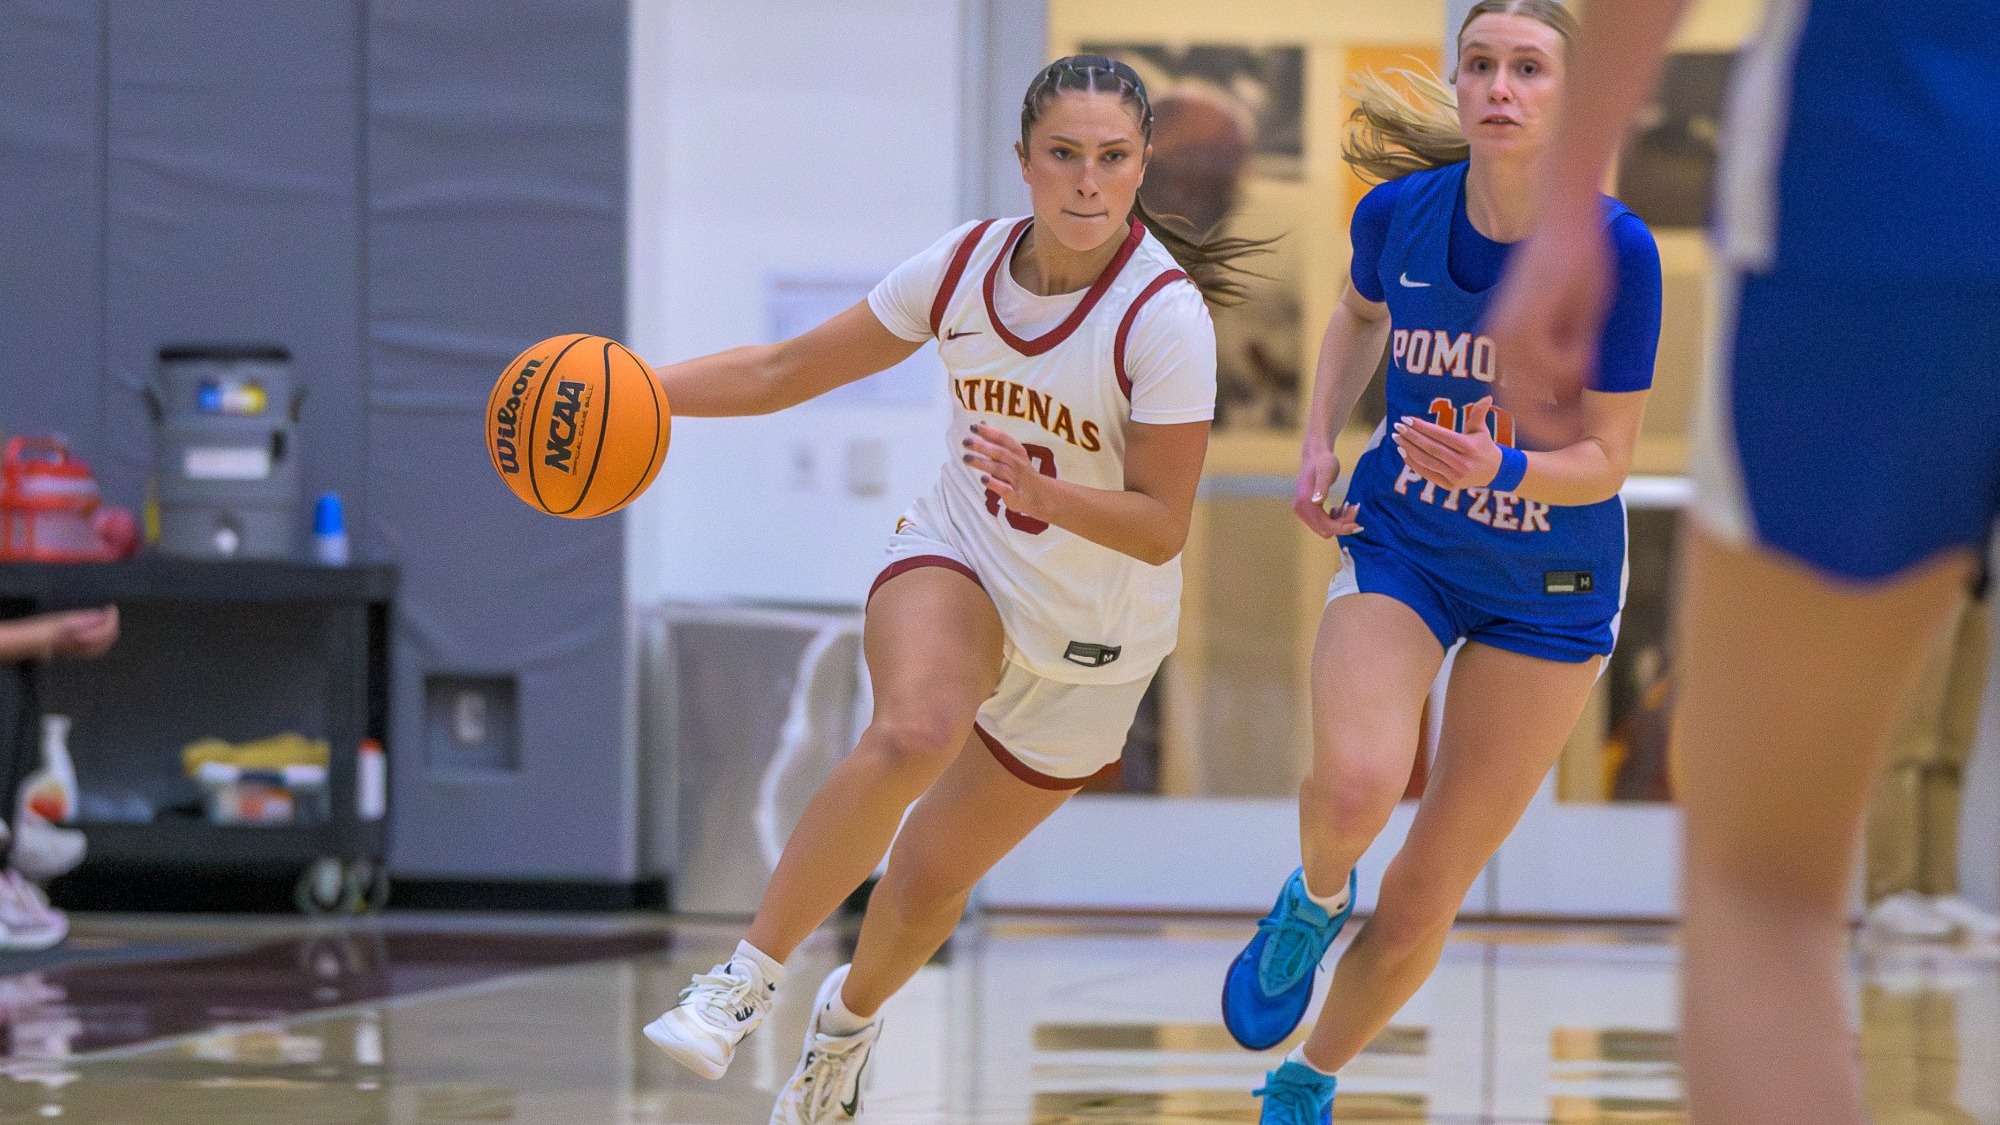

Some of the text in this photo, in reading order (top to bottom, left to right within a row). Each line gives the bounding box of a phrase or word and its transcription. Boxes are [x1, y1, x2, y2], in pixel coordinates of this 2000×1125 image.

[1393, 328, 1498, 383] POMO
[497, 359, 543, 475] Wilson
[544, 379, 586, 474] NCAA
[954, 378, 1101, 452] ATHENAS
[1580, 576, 1590, 588] M
[1103, 653, 1114, 662] M
